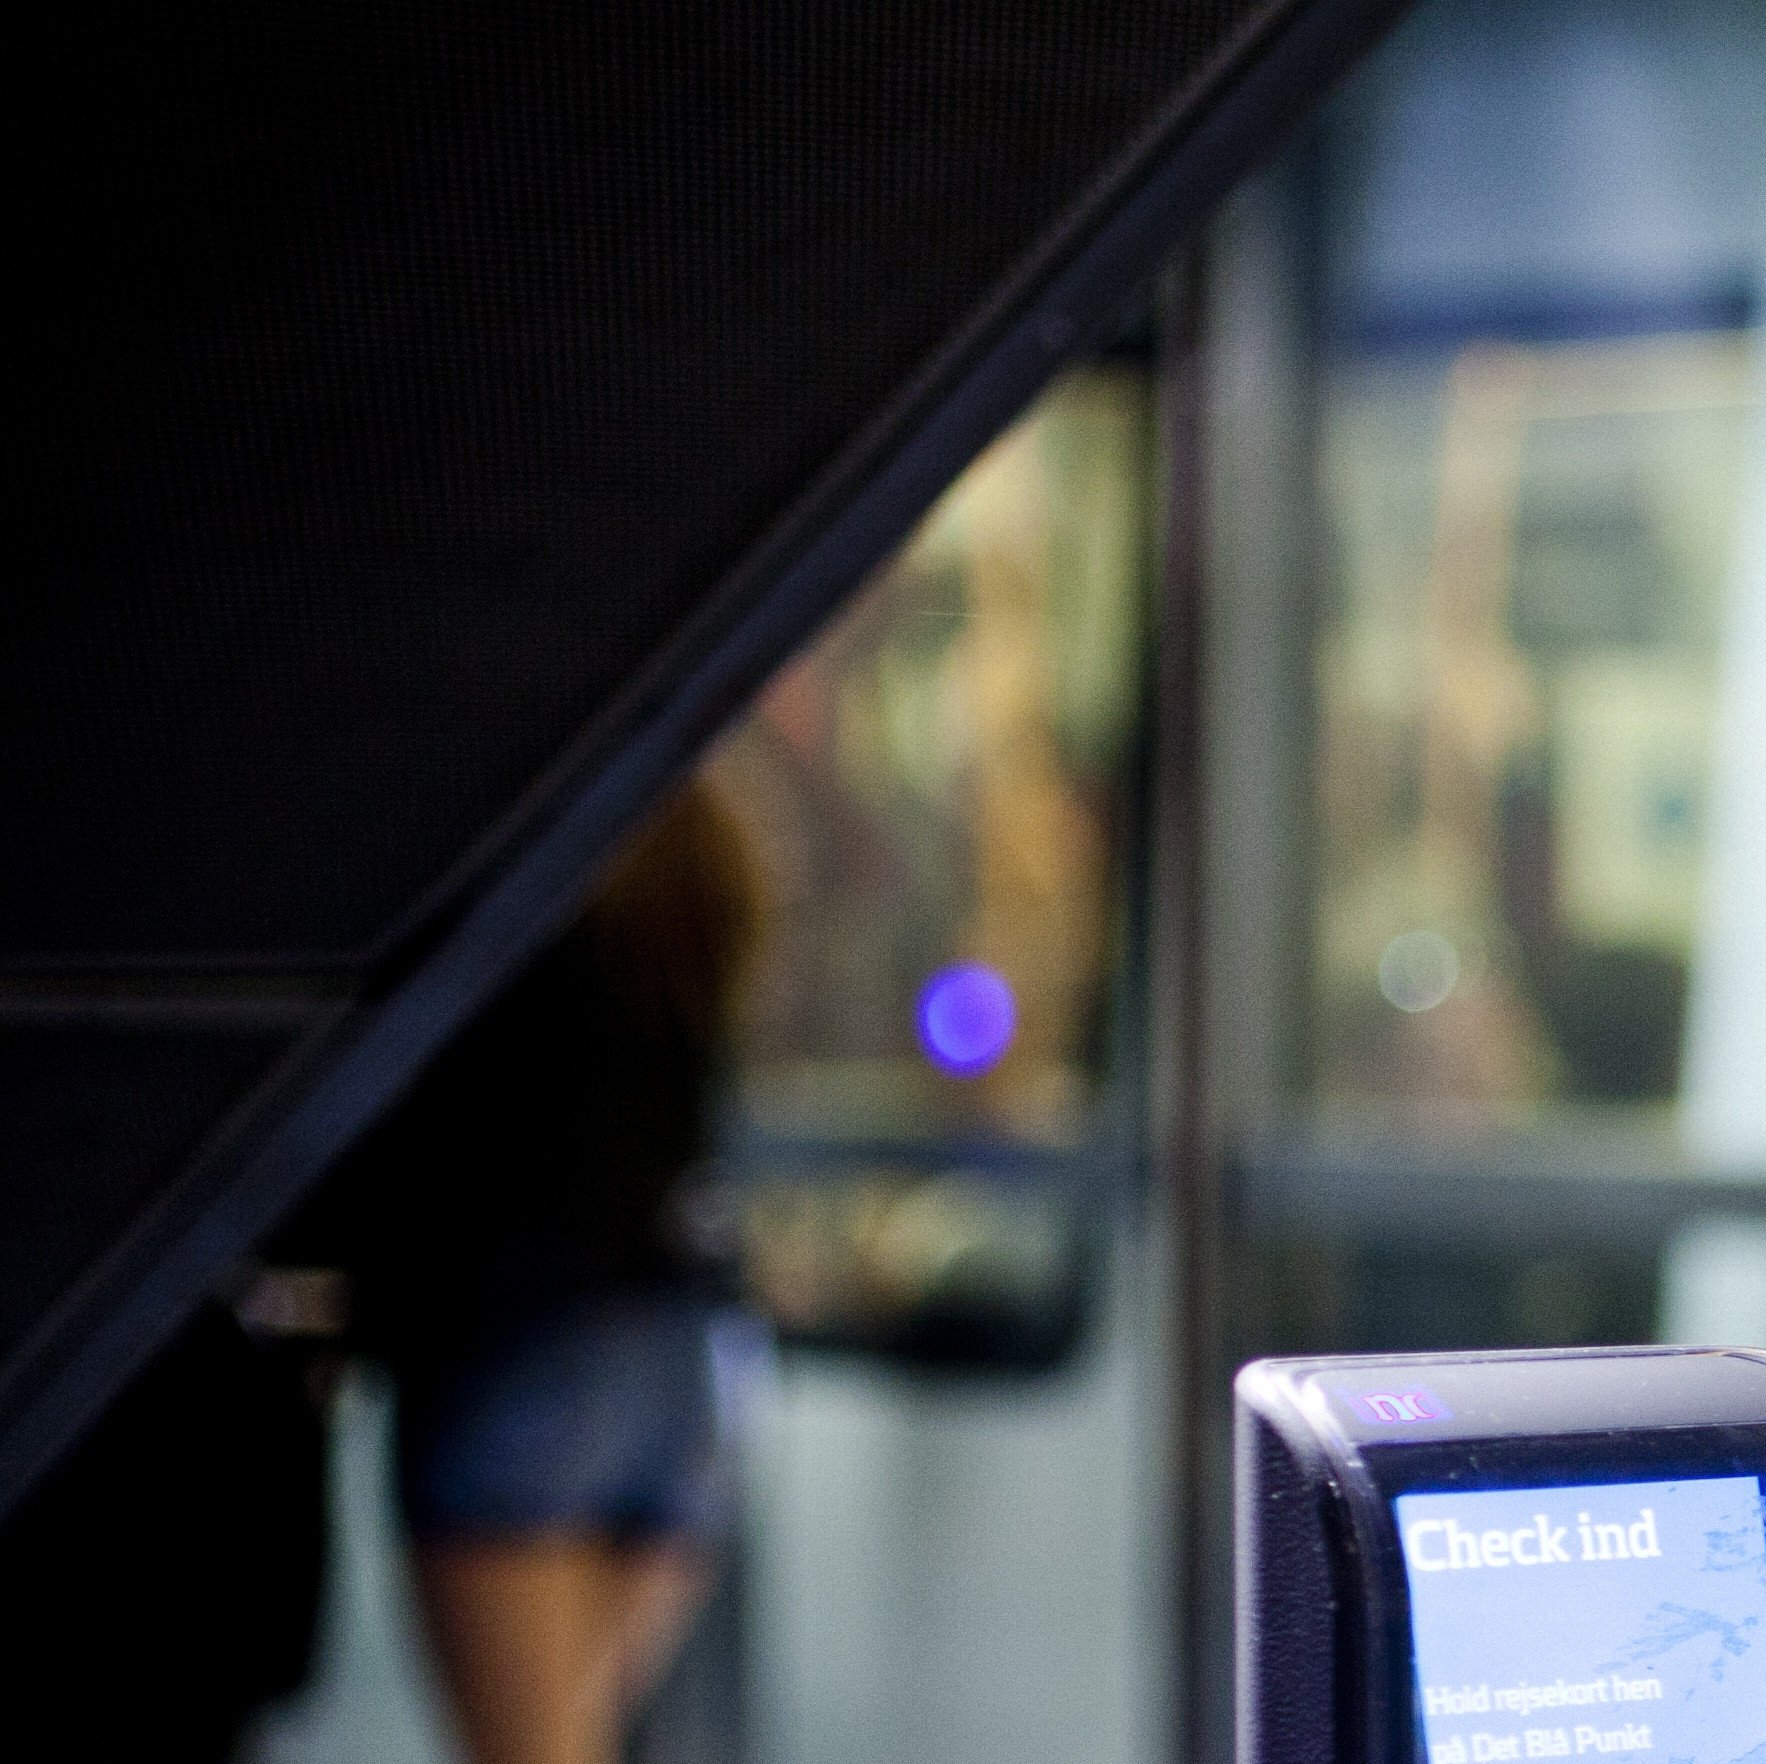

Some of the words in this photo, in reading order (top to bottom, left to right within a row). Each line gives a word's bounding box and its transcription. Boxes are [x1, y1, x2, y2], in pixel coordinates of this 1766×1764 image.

[1408, 1515, 1570, 1571] Check
[1578, 1509, 1661, 1560] ind
[1425, 1684, 1490, 1716] Hold
[1494, 1677, 1609, 1716] rejsekort
[1612, 1674, 1662, 1702] hen
[1472, 1732, 1521, 1763] Det
[1525, 1727, 1570, 1757] Blå
[1573, 1723, 1654, 1754] Punkt
